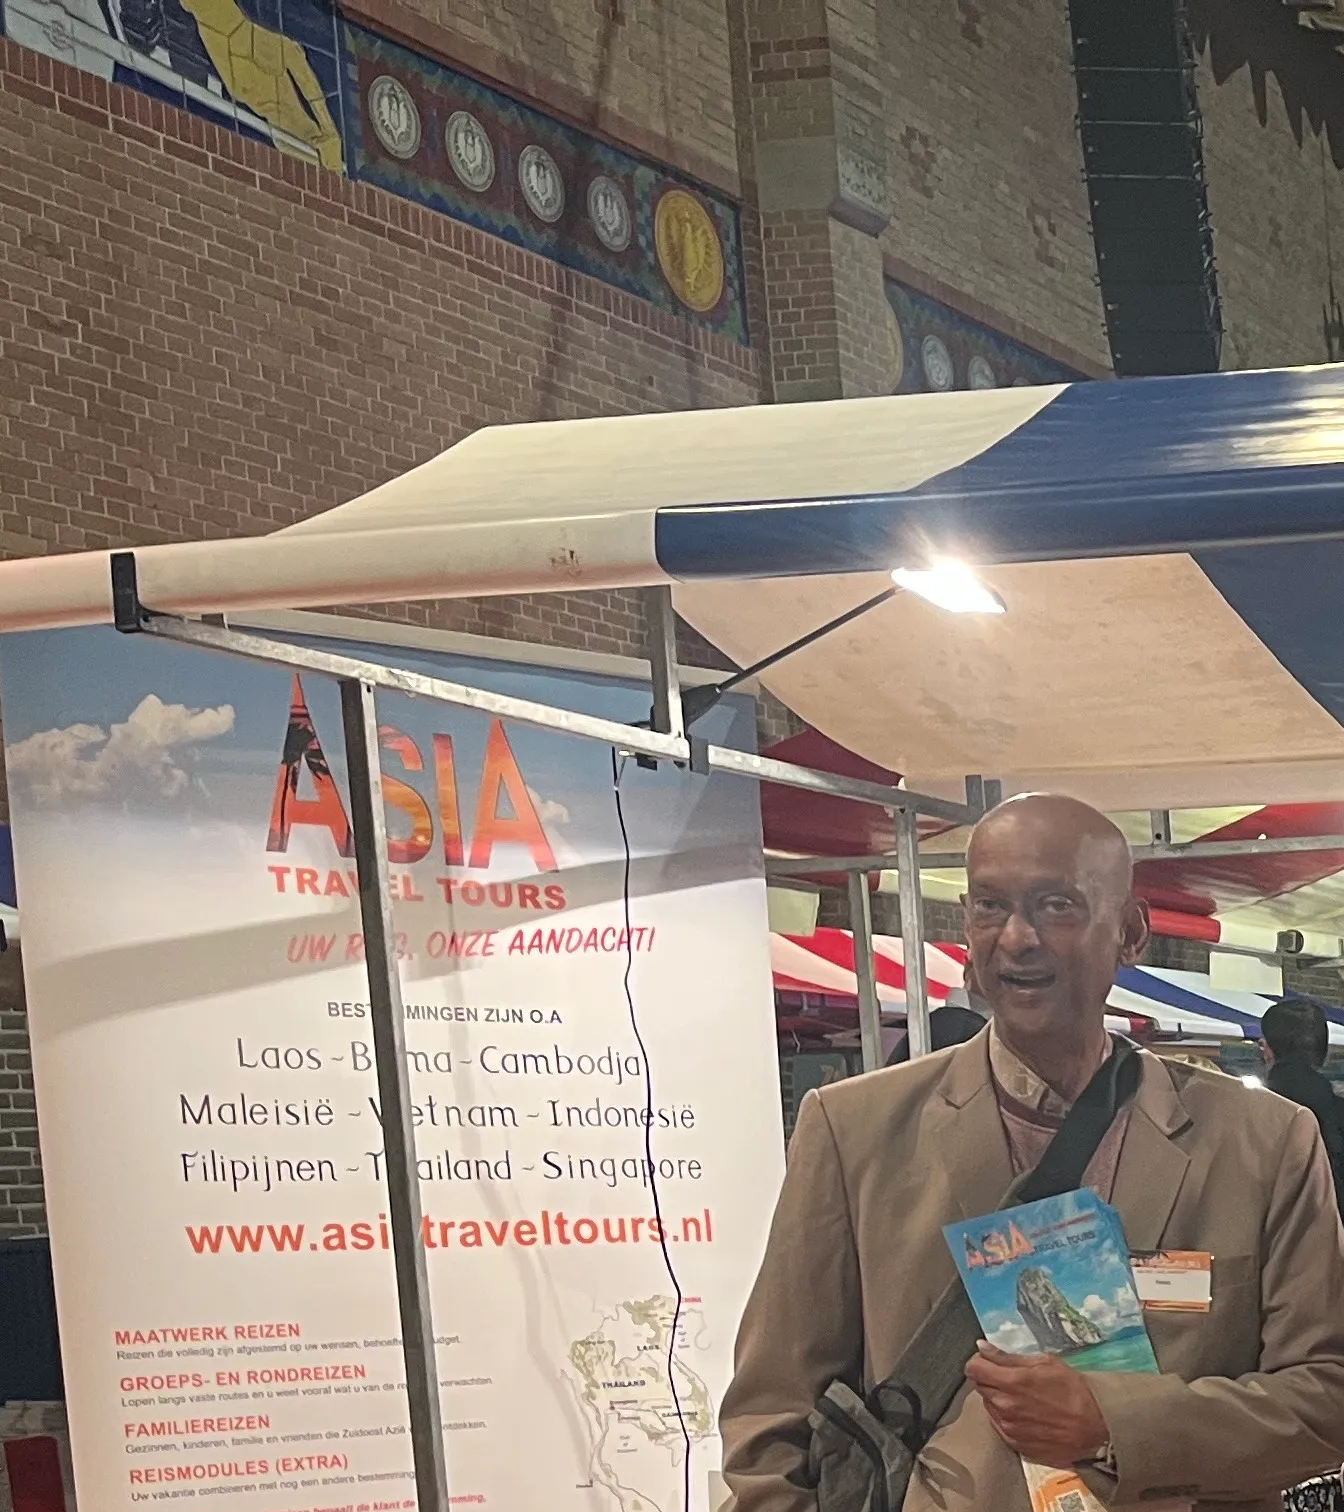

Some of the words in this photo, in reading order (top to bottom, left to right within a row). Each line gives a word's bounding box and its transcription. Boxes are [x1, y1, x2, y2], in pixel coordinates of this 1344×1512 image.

[266, 673, 560, 873] ASIA
[436, 876, 567, 911] TOURS
[286, 932, 337, 963] UW
[425, 929, 500, 958] ONZE
[327, 1001, 479, 1022] BESMINGEN
[484, 1006, 524, 1024] ZIJN
[236, 1037, 322, 1070] Laos
[351, 1041, 452, 1075] Bma
[479, 1043, 642, 1085] Cambodja
[180, 1093, 334, 1127] Maleisië
[547, 1097, 696, 1130] Indonesië
[181, 1150, 338, 1192] Filipijnen
[364, 1150, 511, 1181] Tailand
[542, 1151, 703, 1188] Singapore
[184, 1208, 713, 1254] www.asitraveltours.nl
[963, 1219, 1035, 1273] ASIA
[115, 1326, 229, 1346] MAATWERK
[234, 1323, 301, 1340] REIZEN
[120, 1374, 210, 1392] GROEPS-
[216, 1371, 240, 1387] EN
[247, 1364, 366, 1384] RONDREIZEN
[124, 1414, 271, 1438] FAMILIEREIZEN
[129, 1459, 270, 1485] REISMODULES
[275, 1454, 349, 1476] (EXTRA)
